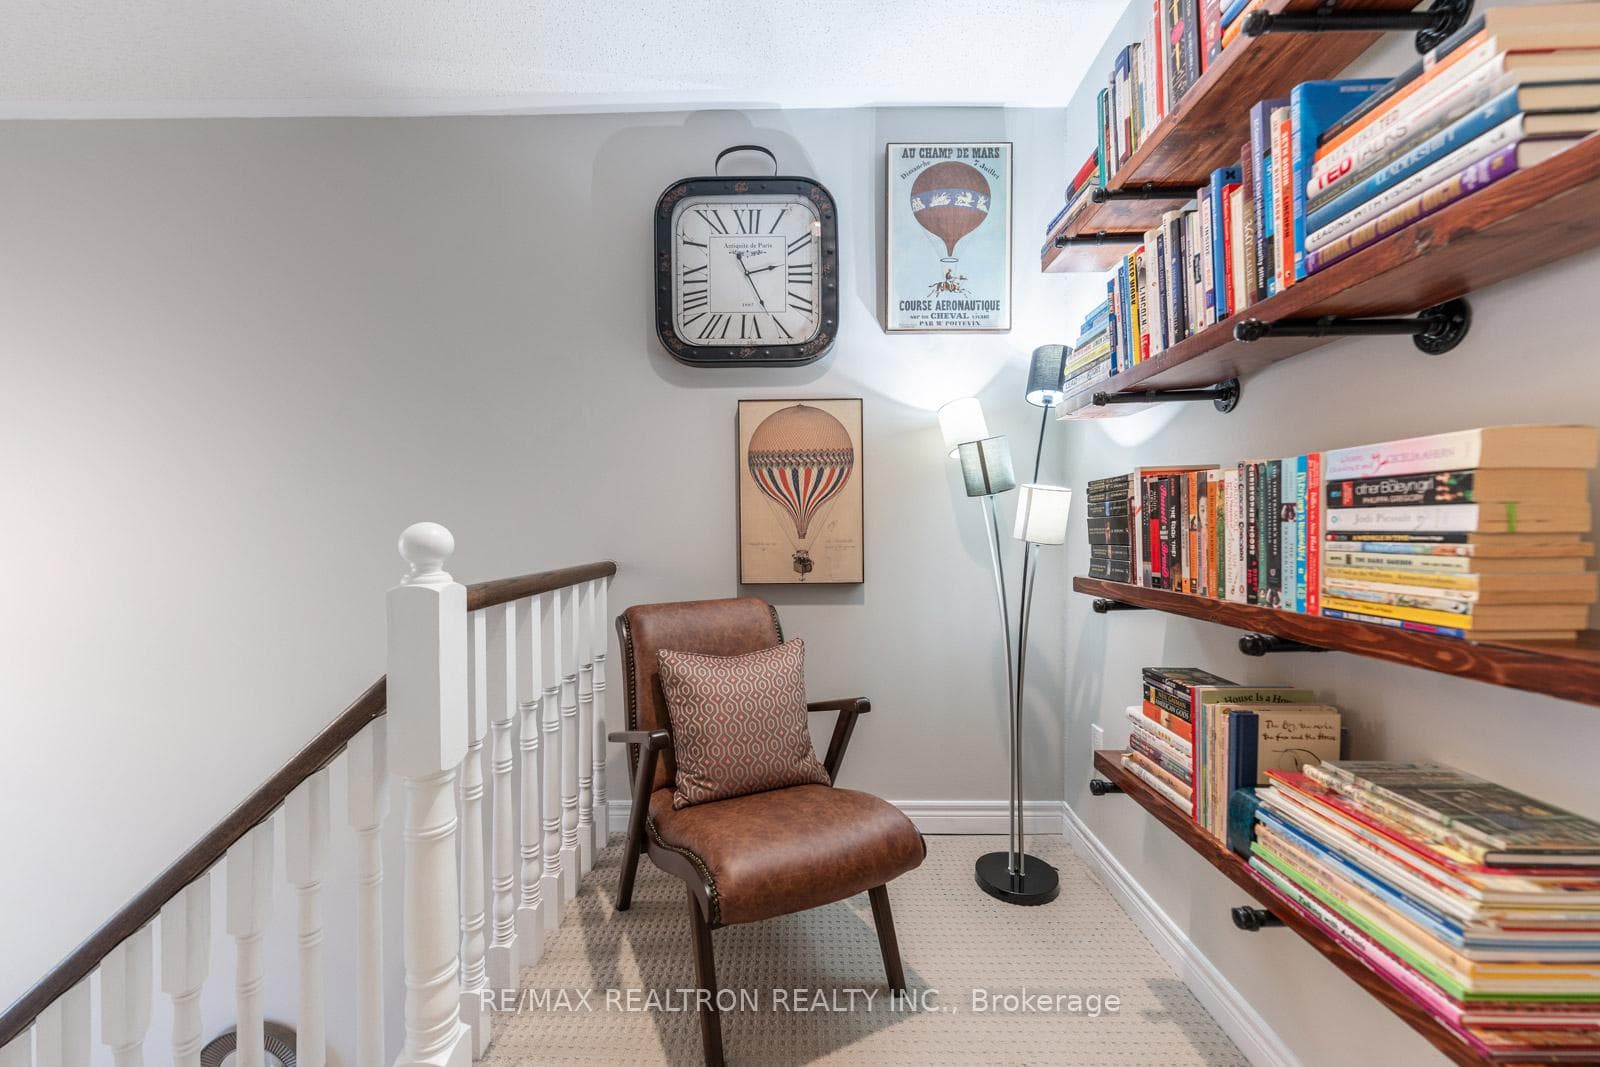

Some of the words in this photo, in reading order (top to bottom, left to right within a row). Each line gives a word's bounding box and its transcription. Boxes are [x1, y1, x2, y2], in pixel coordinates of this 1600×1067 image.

[902, 147, 916, 159] AU
[918, 147, 954, 159] CHAMP
[956, 147, 969, 159] DE
[972, 147, 1000, 159] MARS
[1280, 131, 1289, 154] SETH
[900, 160, 931, 181] Dimanche
[979, 163, 1001, 180] Juillet
[1317, 157, 1352, 190] TED
[732, 208, 762, 234] XII
[1283, 195, 1291, 239] LINCHPIN
[899, 300, 932, 311] COURSE
[935, 300, 1001, 312] AERONAUTIQUE
[930, 312, 970, 320] CHEVAL
[1355, 482, 1380, 496] other
[1380, 479, 1417, 494] Boleyn
[1160, 484, 1168, 523] Russell
[1354, 514, 1373, 525] Jodi
[1155, 697, 1176, 713] AMERICAN
[1176, 706, 1189, 720] GODS
